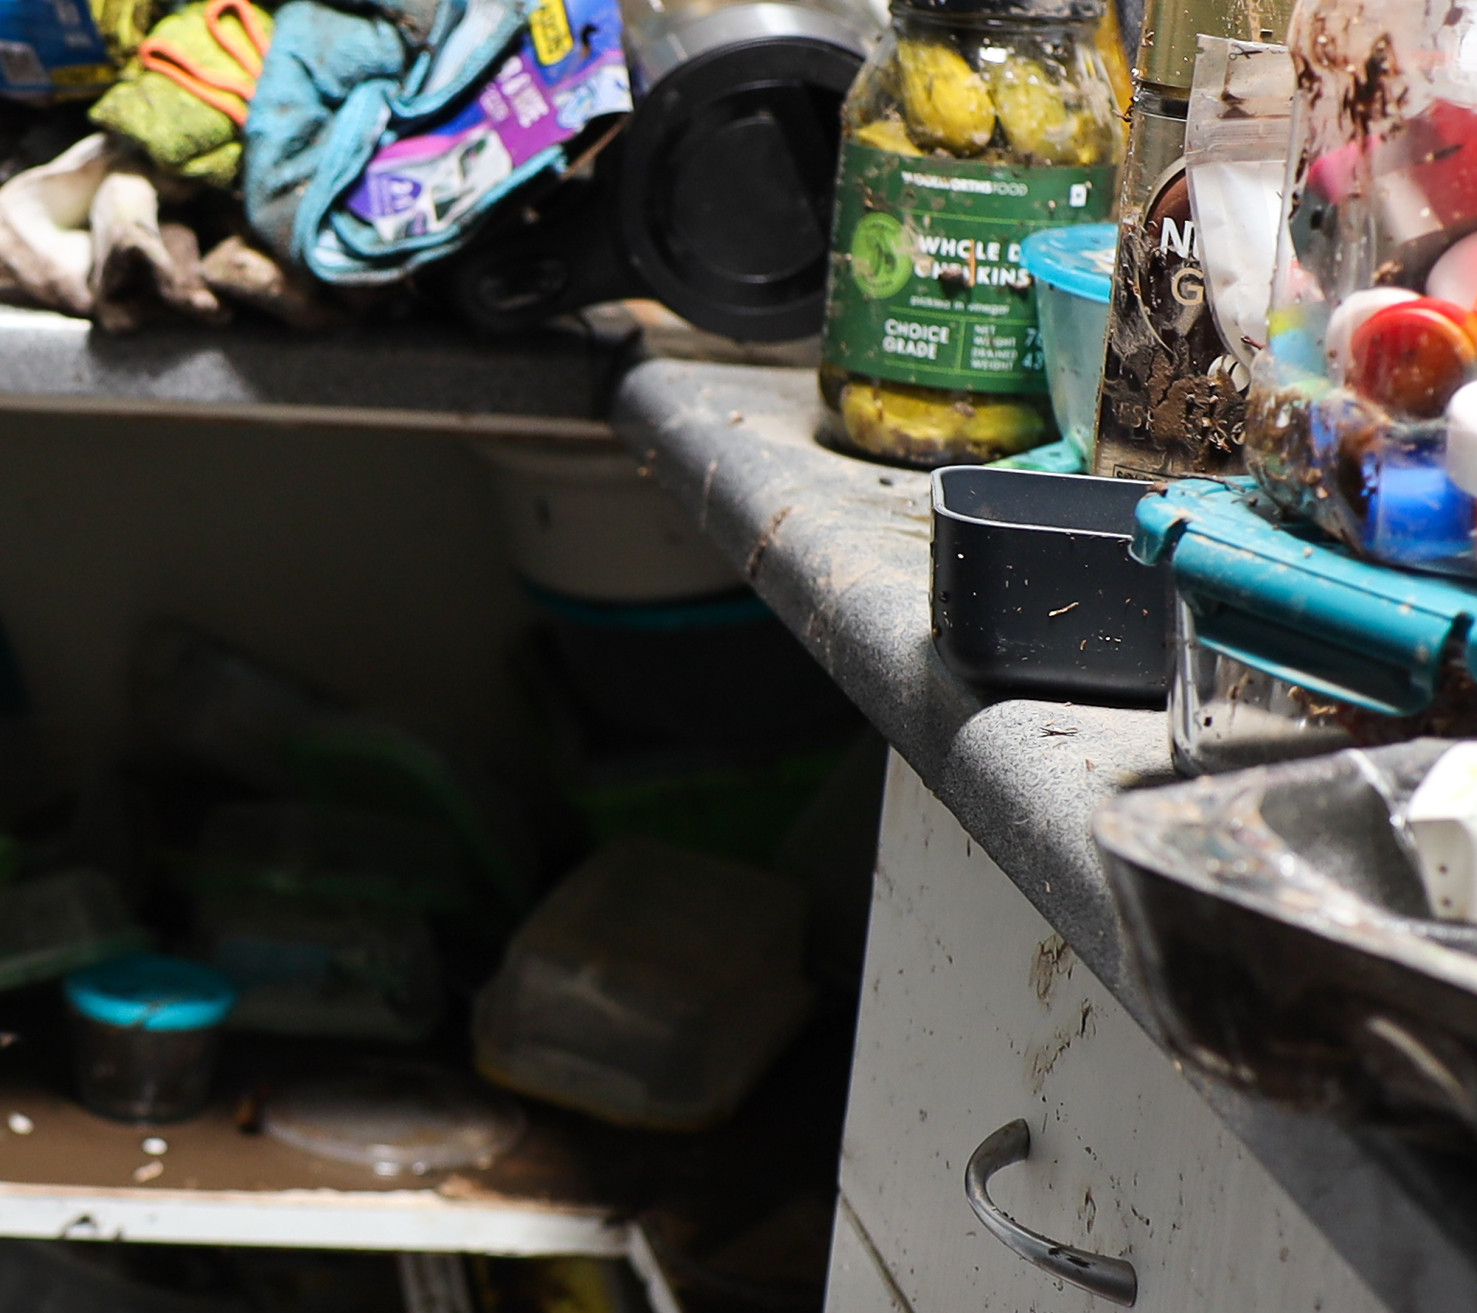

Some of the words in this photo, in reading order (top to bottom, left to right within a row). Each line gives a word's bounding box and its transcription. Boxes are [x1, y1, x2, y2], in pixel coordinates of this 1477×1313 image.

[884, 318, 950, 345] CHOICE
[973, 324, 997, 336] NET
[882, 336, 938, 360] GRADE
[970, 359, 1014, 372] WEIGHT
